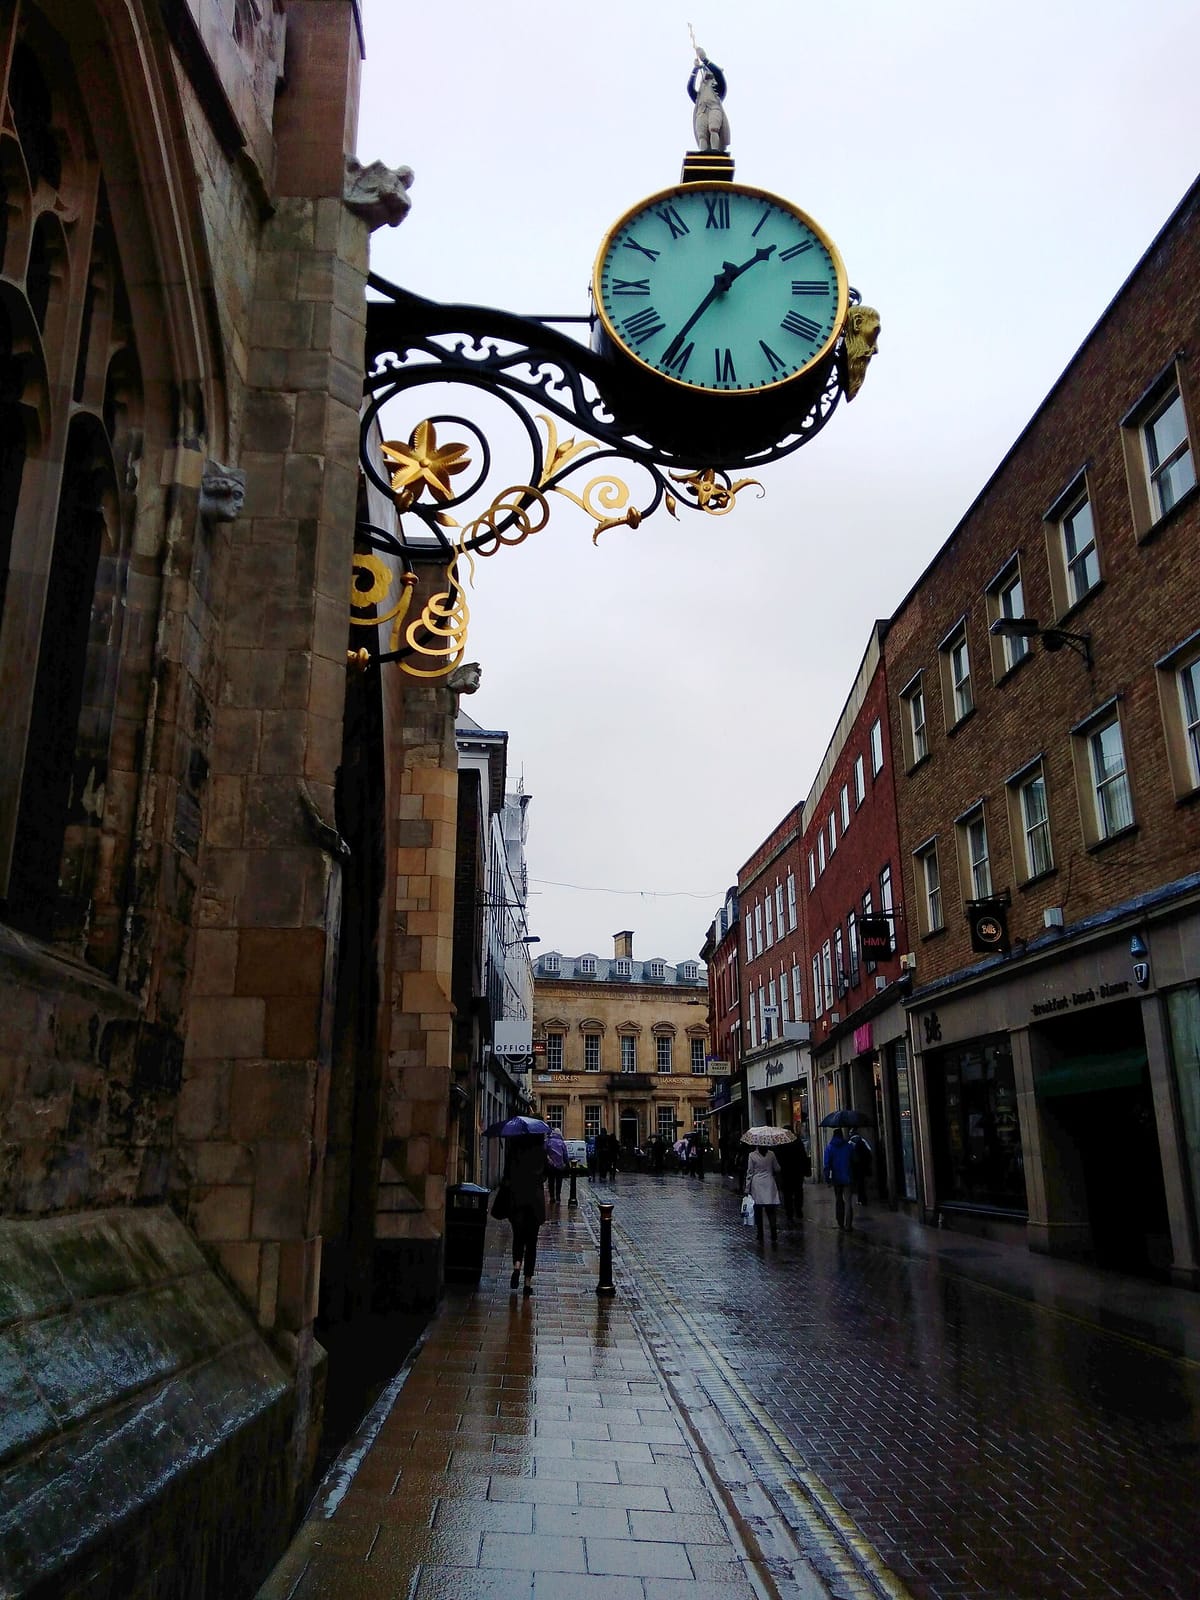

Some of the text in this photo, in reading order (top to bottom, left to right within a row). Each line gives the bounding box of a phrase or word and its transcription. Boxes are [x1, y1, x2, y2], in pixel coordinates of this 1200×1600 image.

[656, 205, 690, 240] XI
[704, 198, 730, 229] XII
[752, 209, 771, 237] I
[622, 237, 660, 262] X
[778, 239, 814, 262] II
[612, 278, 650, 295] IX
[791, 280, 830, 295] III
[621, 306, 666, 345] VIII
[715, 348, 737, 382] VI
[758, 340, 787, 372] V
[863, 936, 886, 947] HMV
[496, 1044, 531, 1052] OFFICE
